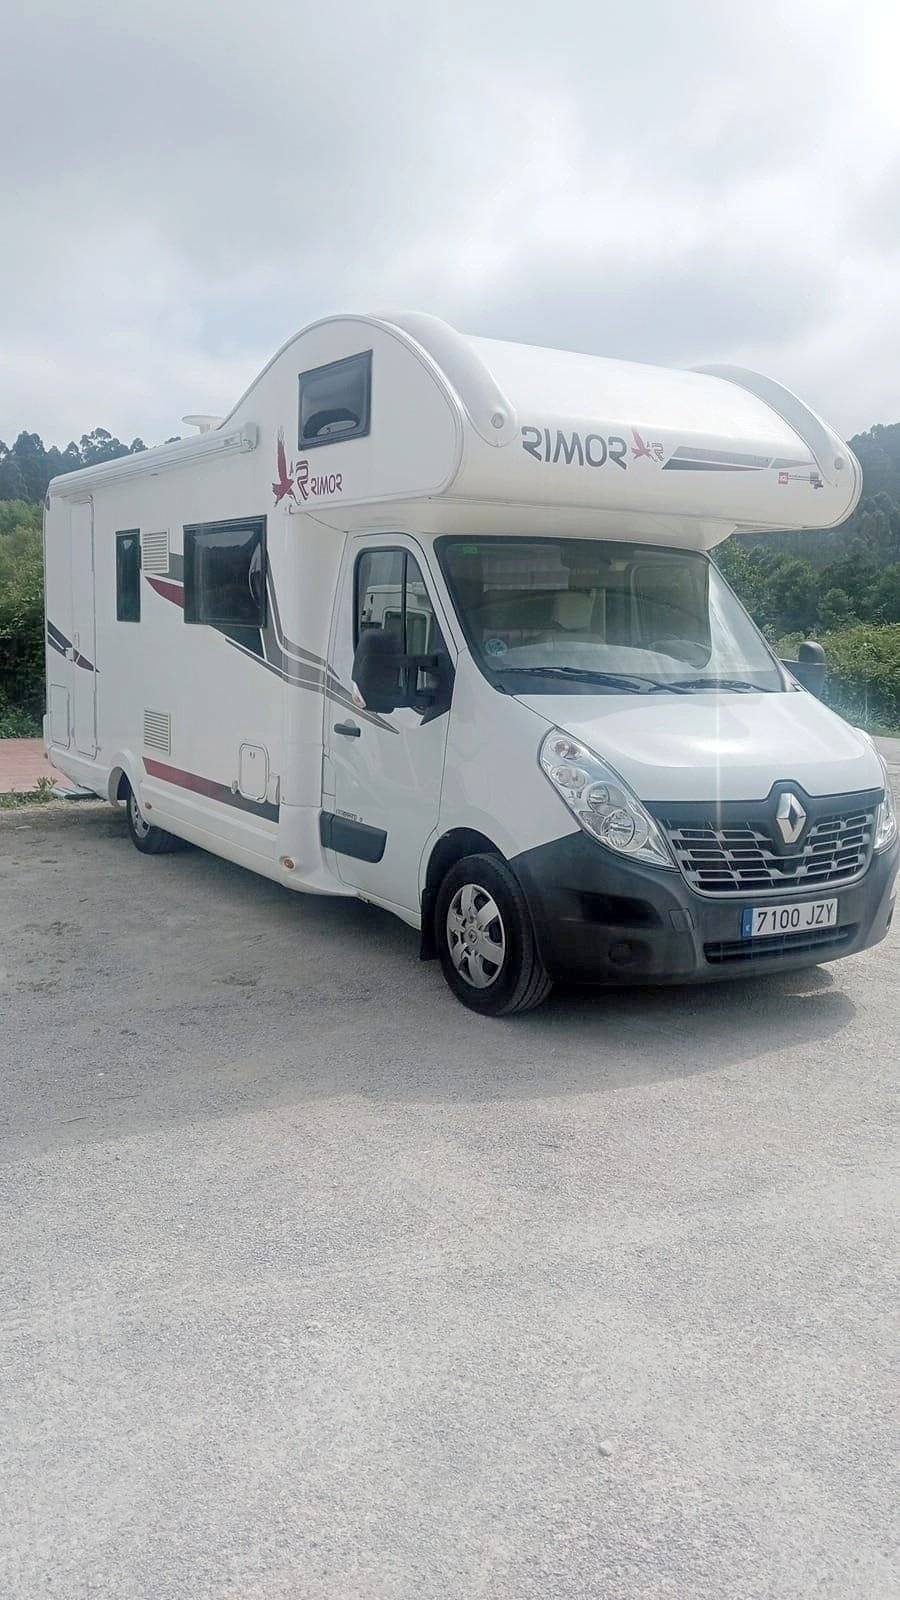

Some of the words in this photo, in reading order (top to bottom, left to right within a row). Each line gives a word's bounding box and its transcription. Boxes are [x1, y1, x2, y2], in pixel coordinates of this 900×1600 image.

[521, 425, 627, 470] RIMOR
[310, 473, 343, 496] RIMOR
[757, 908, 800, 932] 7100
[806, 903, 834, 925] JZY
